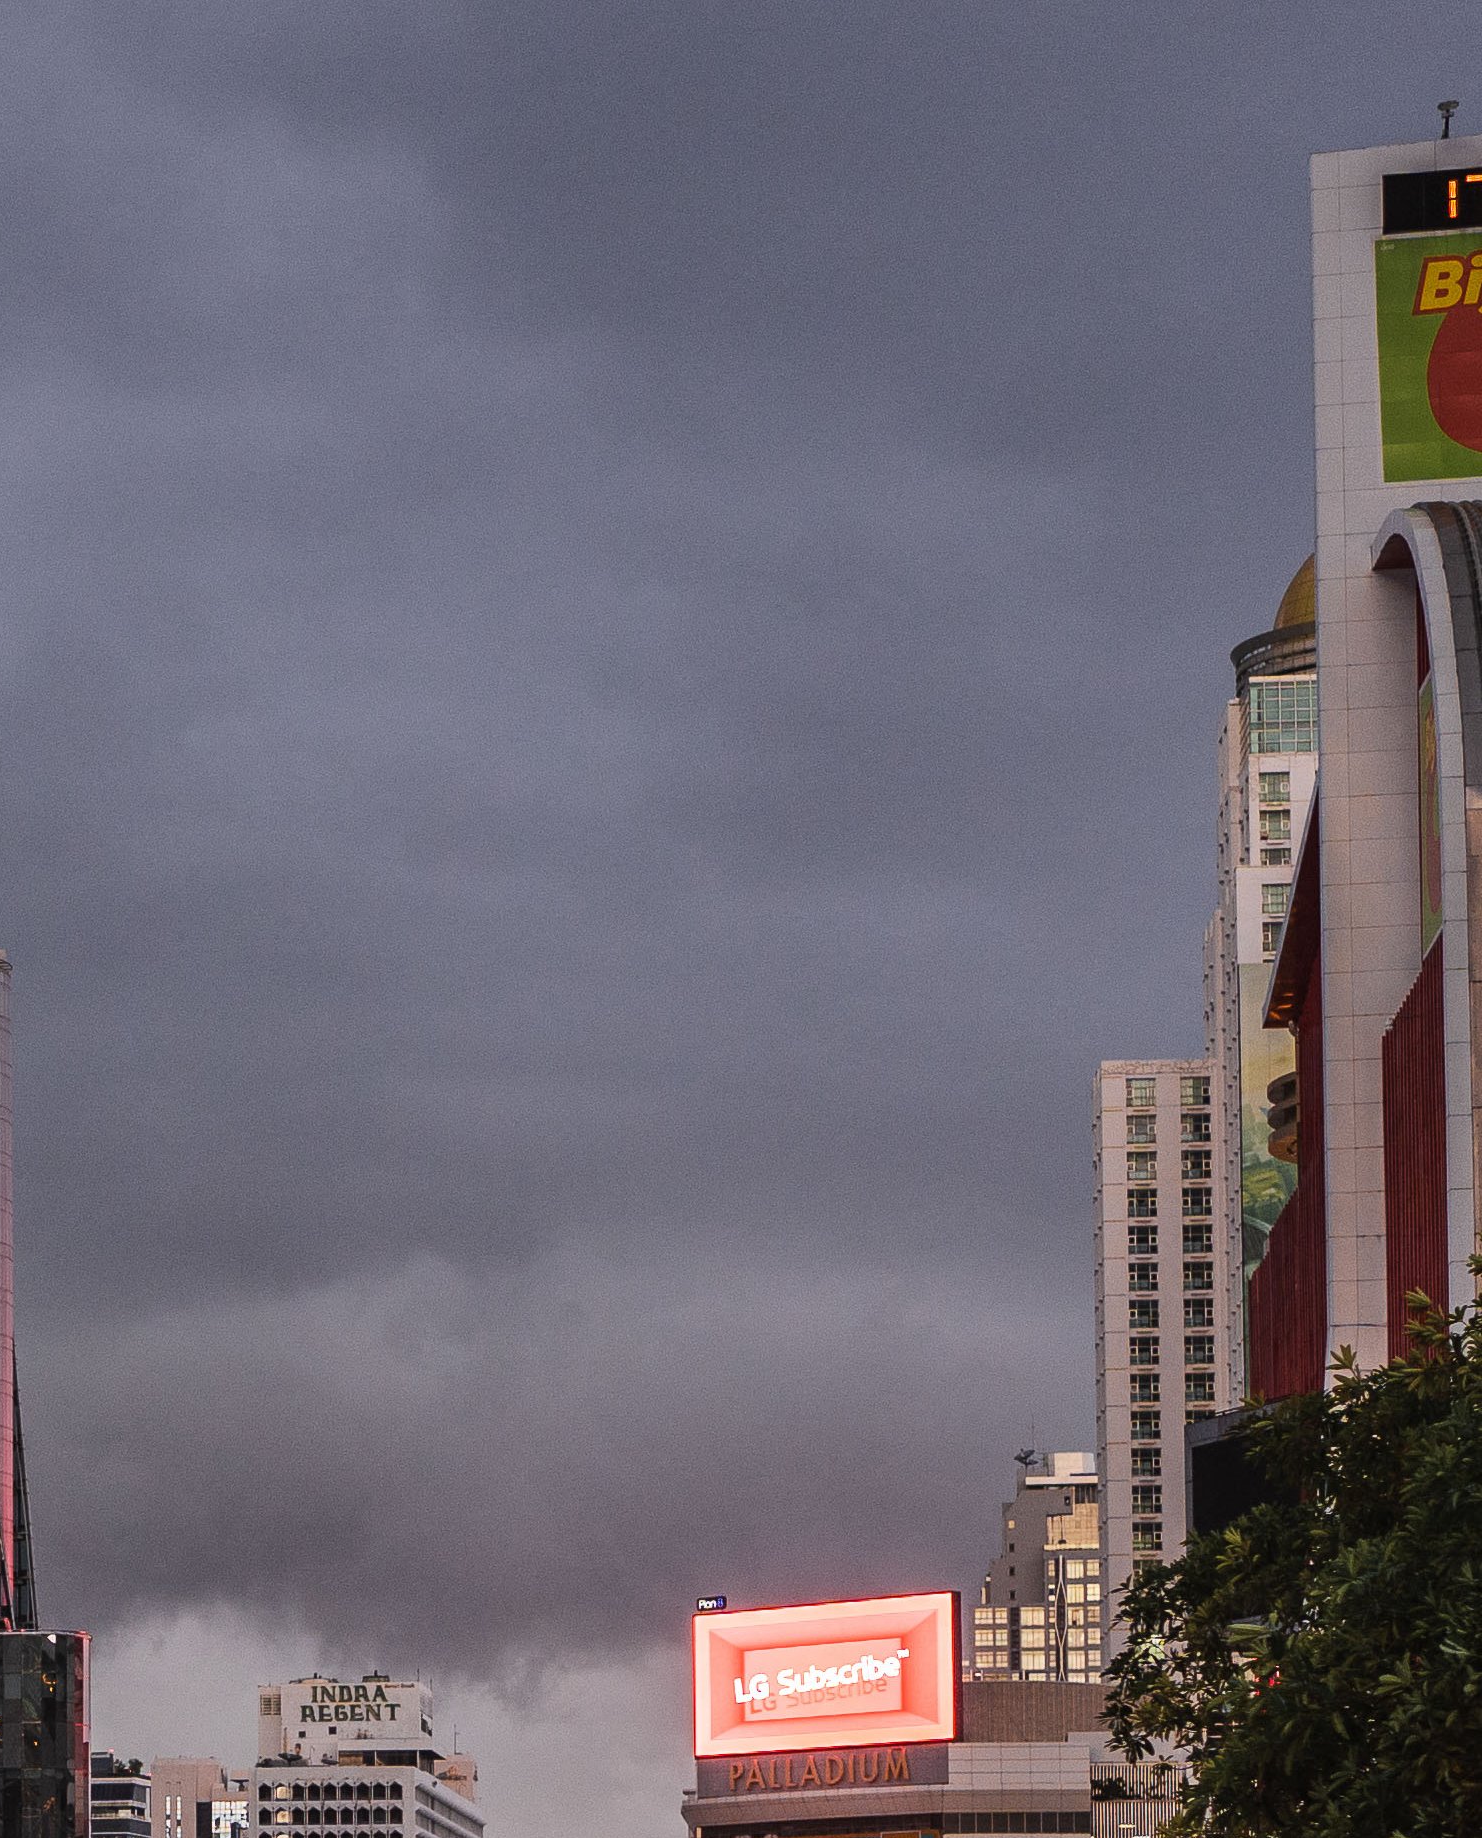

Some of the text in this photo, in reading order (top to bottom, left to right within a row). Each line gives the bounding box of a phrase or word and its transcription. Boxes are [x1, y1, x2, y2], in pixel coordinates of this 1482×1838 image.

[1419, 254, 1482, 313] Bi
[311, 1685, 387, 1703] INDRA
[733, 1673, 770, 1705] LG
[300, 1704, 401, 1722] REGENT
[727, 1747, 911, 1793] PALLADIUM
